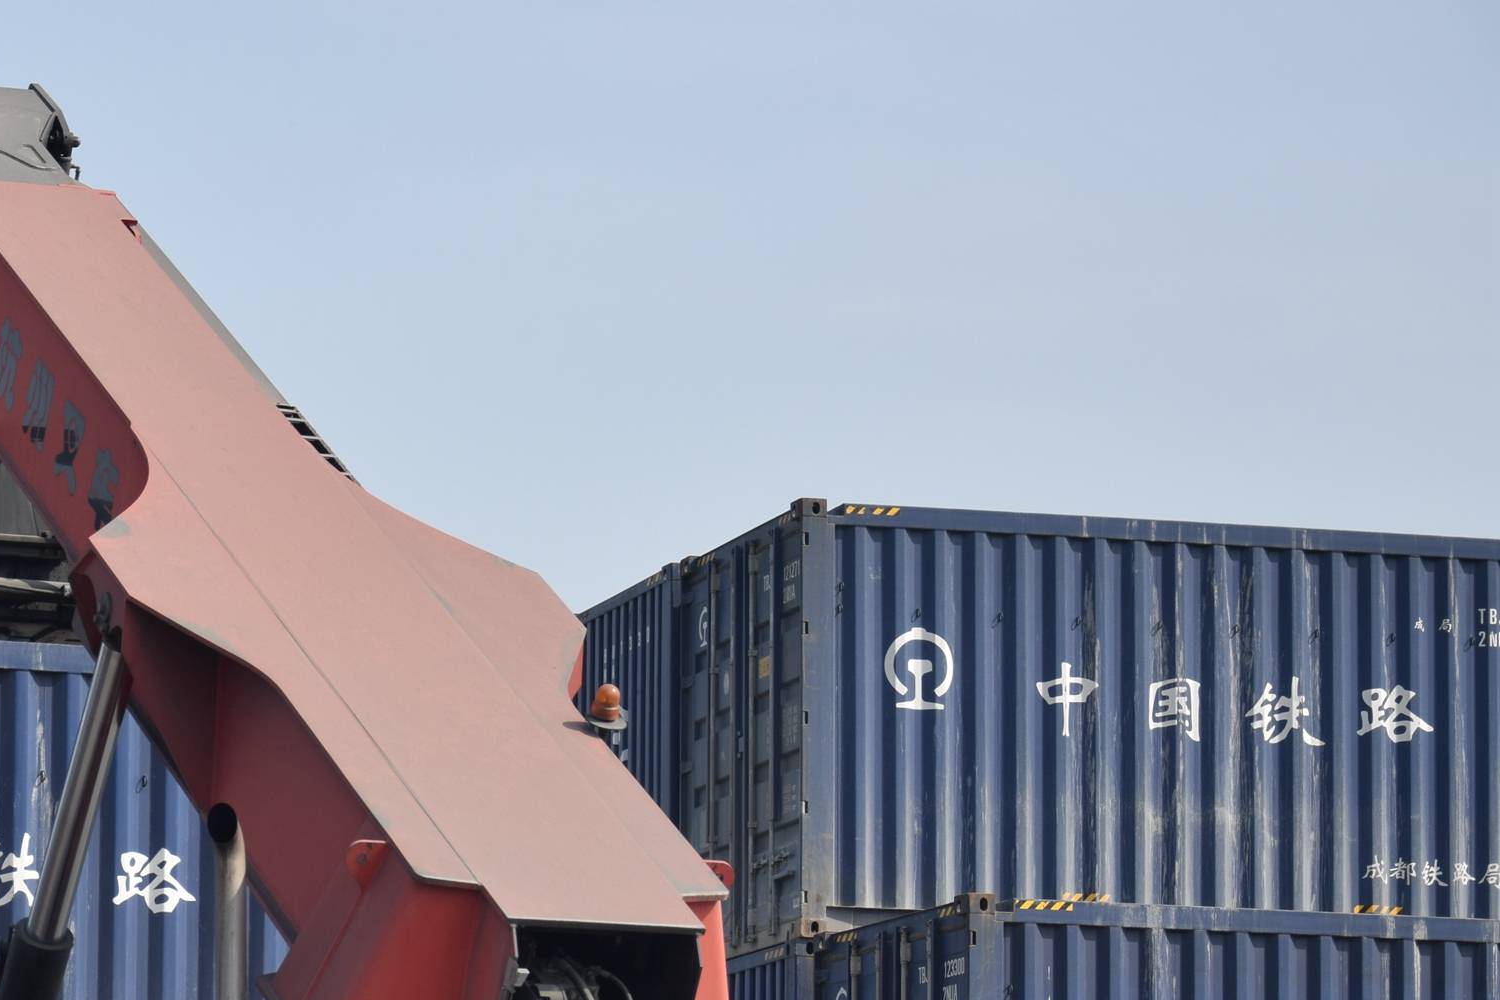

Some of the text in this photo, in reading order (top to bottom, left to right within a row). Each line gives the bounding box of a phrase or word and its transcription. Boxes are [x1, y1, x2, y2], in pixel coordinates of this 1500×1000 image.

[1477, 608, 1500, 625] TB
[1478, 631, 1500, 648] 2N
[1035, 661, 1434, 746] 中国铁路
[1361, 855, 1500, 889] 成都铁路局
